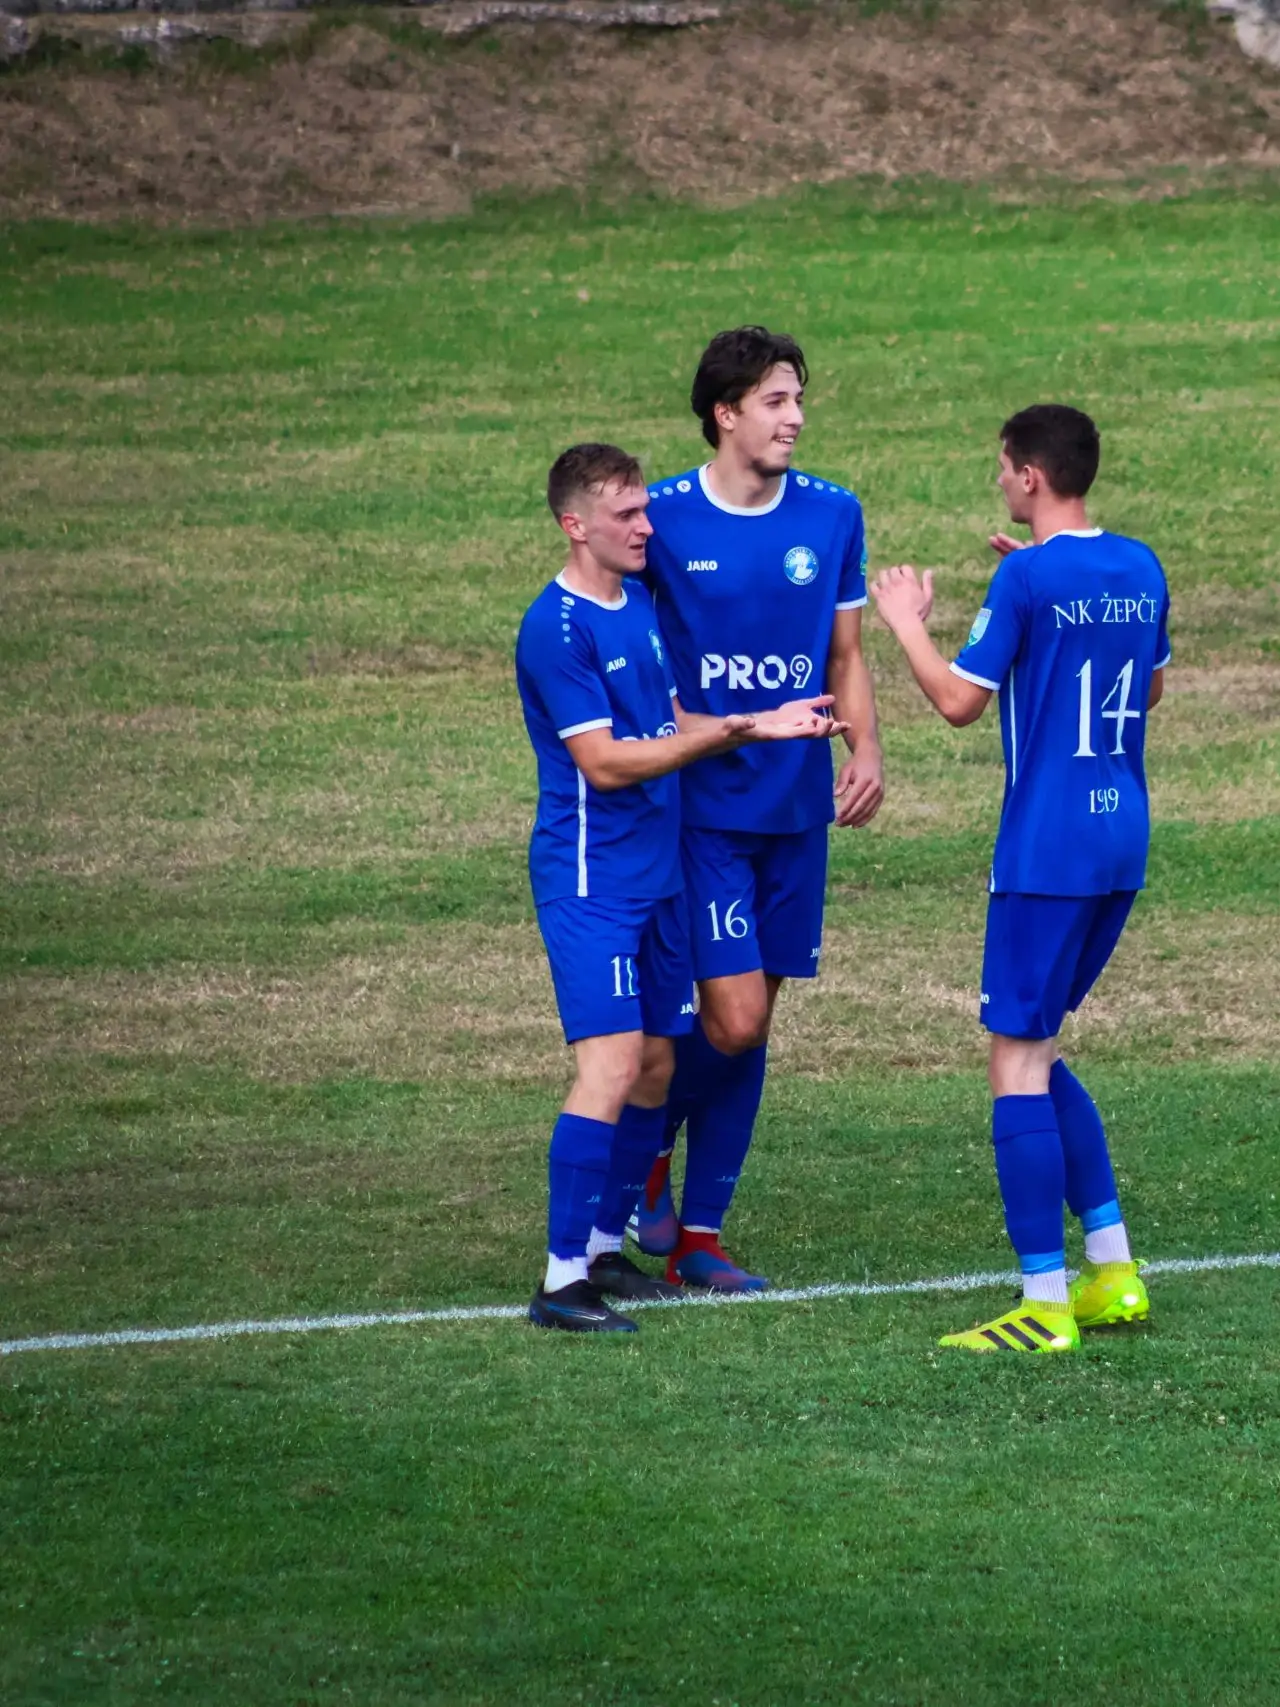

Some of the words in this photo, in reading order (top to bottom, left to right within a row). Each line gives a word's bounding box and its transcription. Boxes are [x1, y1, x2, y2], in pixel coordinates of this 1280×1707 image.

[686, 560, 718, 572] JAKO
[1052, 598, 1094, 628] NK
[701, 653, 813, 690] PRO9
[1073, 658, 1141, 757] 14
[707, 899, 748, 941] 16
[610, 955, 638, 997] 11
